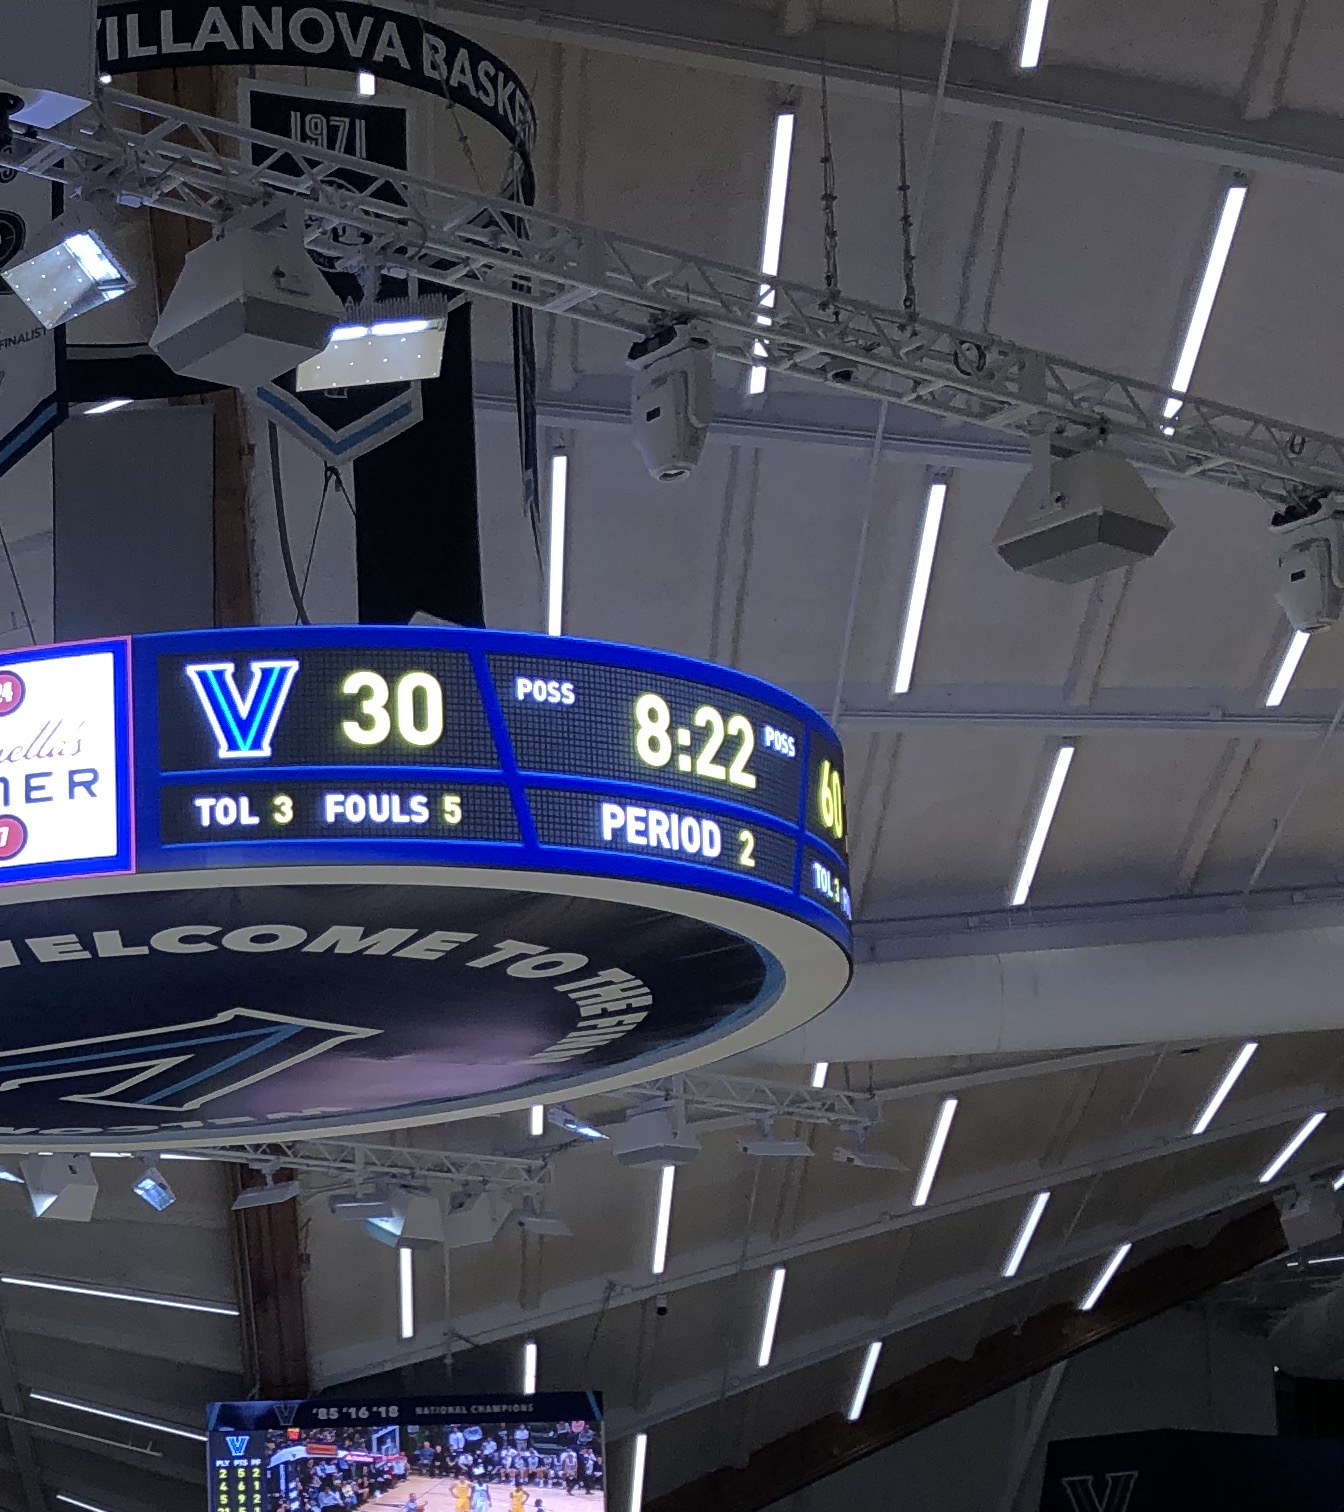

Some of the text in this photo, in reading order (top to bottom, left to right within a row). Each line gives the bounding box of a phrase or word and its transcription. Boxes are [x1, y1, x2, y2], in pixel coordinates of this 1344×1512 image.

[290, 109, 367, 160] 1971
[516, 676, 576, 705] POSS
[341, 670, 445, 748] 30
[635, 692, 757, 790] 8:22
[763, 725, 797, 758] POSS
[194, 793, 463, 827] TOL 3 FOULS 5
[601, 802, 757, 867] PERIOD 2
[813, 861, 833, 897] TOL
[832, 877, 841, 903] 3
[464, 938, 589, 979] TO
[469, 1402, 535, 1415] CHAMPIONS
[218, 1467, 262, 1479] 2 5 2
[253, 1480, 261, 1491] 1
[252, 1493, 262, 1504] 2
